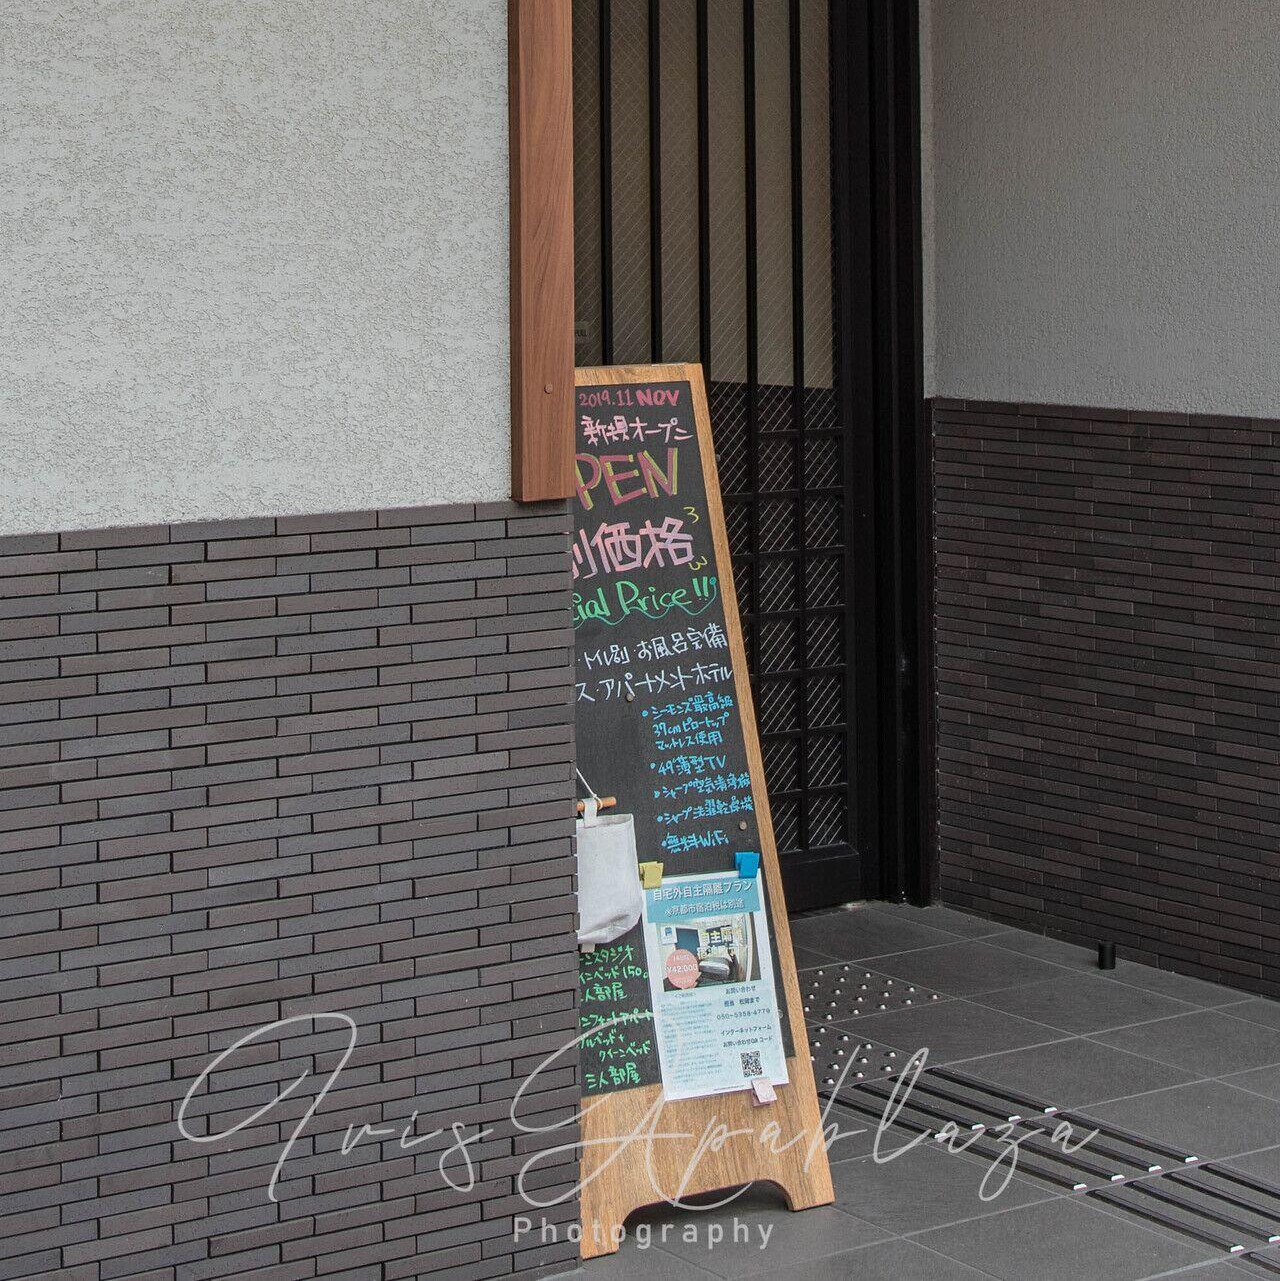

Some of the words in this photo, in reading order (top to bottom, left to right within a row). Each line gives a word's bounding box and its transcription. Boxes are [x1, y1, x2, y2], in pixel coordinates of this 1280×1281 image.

[636, 388, 680, 407] NOV
[580, 415, 694, 447] 新規オープン
[585, 1061, 641, 1090] 三人部屋
